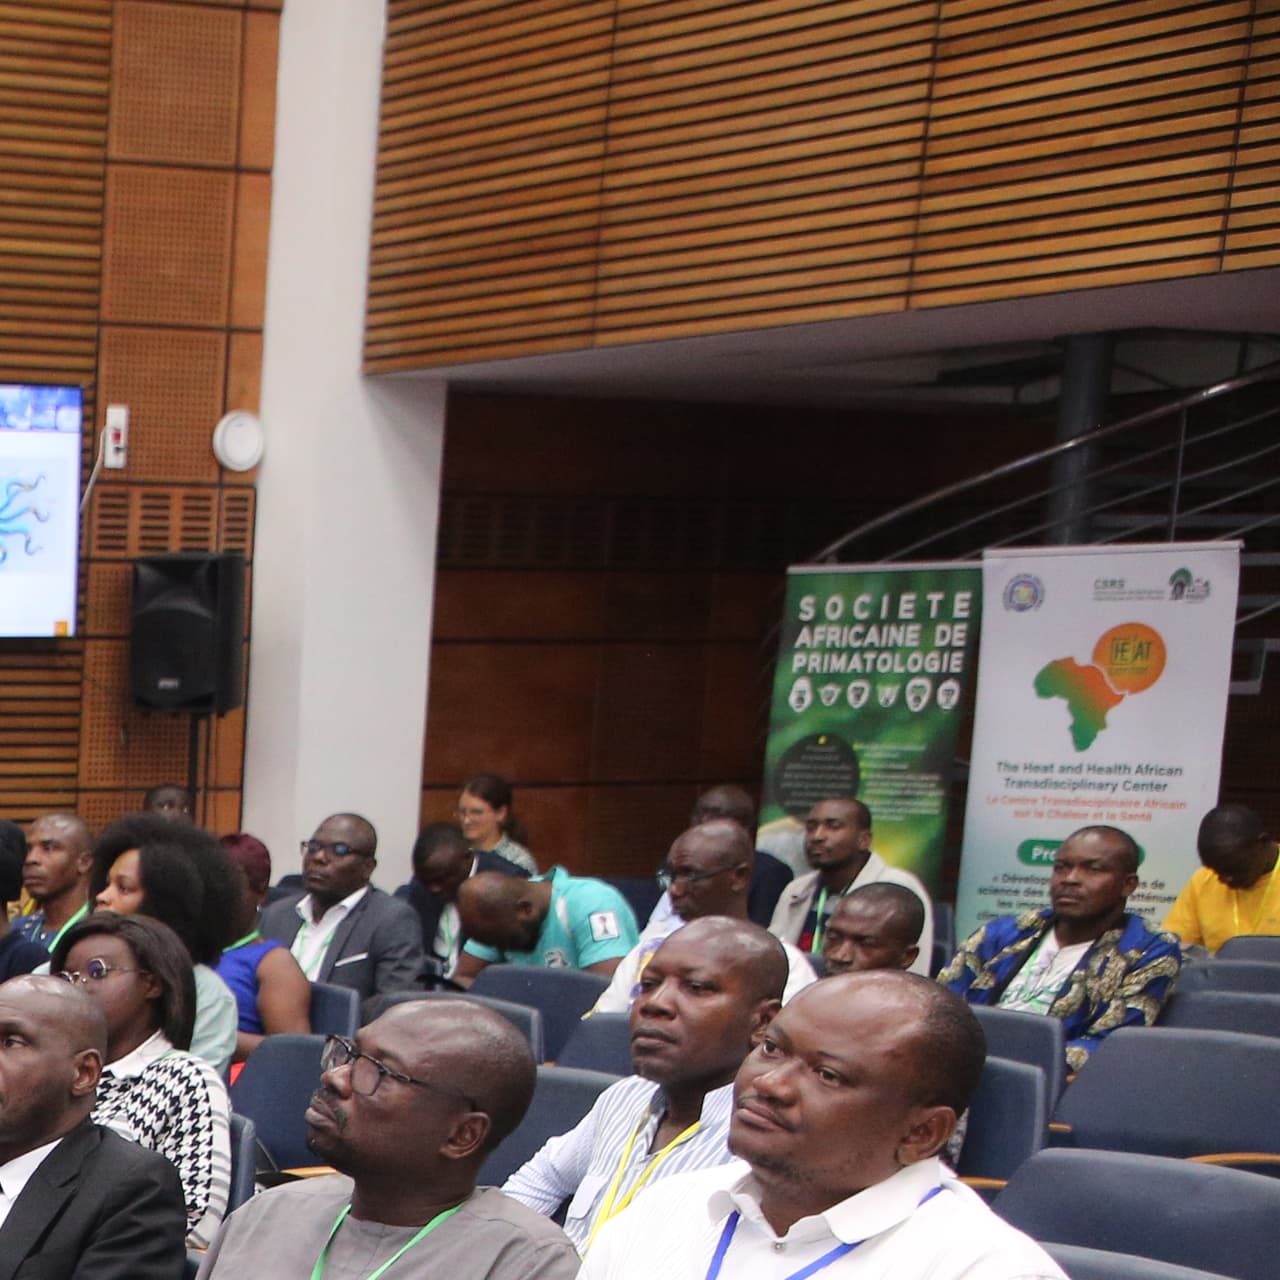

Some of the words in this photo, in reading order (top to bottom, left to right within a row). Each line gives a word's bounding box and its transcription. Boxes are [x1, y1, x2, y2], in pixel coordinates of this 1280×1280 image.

[798, 591, 972, 621] SOCIETE
[794, 622, 921, 649] AFRICAINE
[934, 622, 968, 648] DE
[792, 650, 965, 674] PRIMATOLOGIE
[996, 761, 1019, 774] The
[1023, 761, 1055, 774] Heat
[1058, 762, 1083, 775] and
[1086, 763, 1132, 776] Health
[1135, 764, 1183, 777] African
[1003, 777, 1119, 792] Transdisciplinary
[1122, 779, 1168, 792] Center
